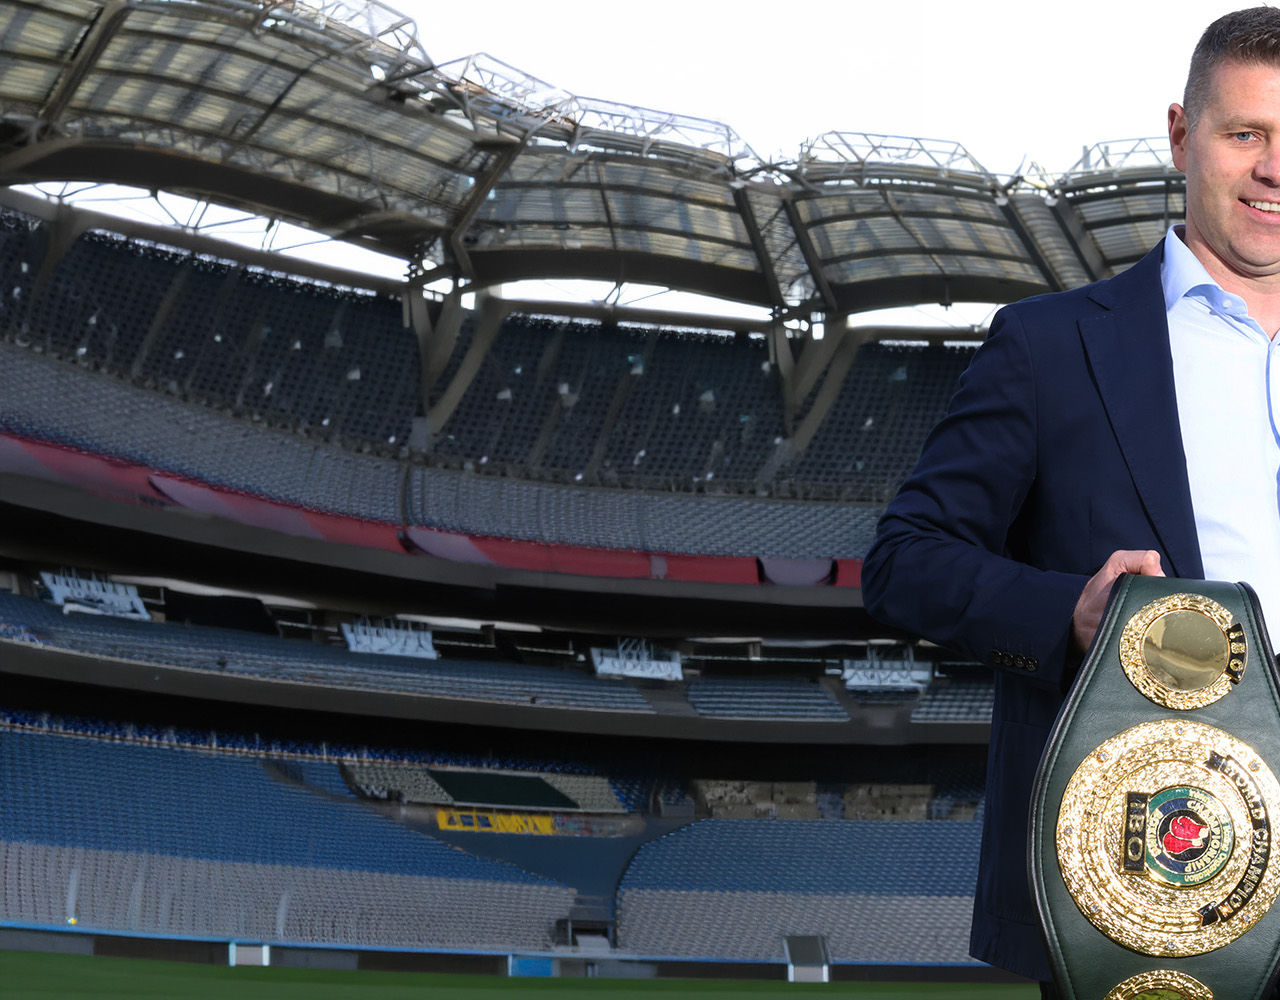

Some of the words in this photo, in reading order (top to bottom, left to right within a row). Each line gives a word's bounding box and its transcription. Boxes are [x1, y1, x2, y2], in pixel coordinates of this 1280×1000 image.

[1128, 801, 1144, 862] IBO
[1184, 800, 1221, 873] CHAMPIONSHIP
[1218, 828, 1269, 916] CHAMPION
